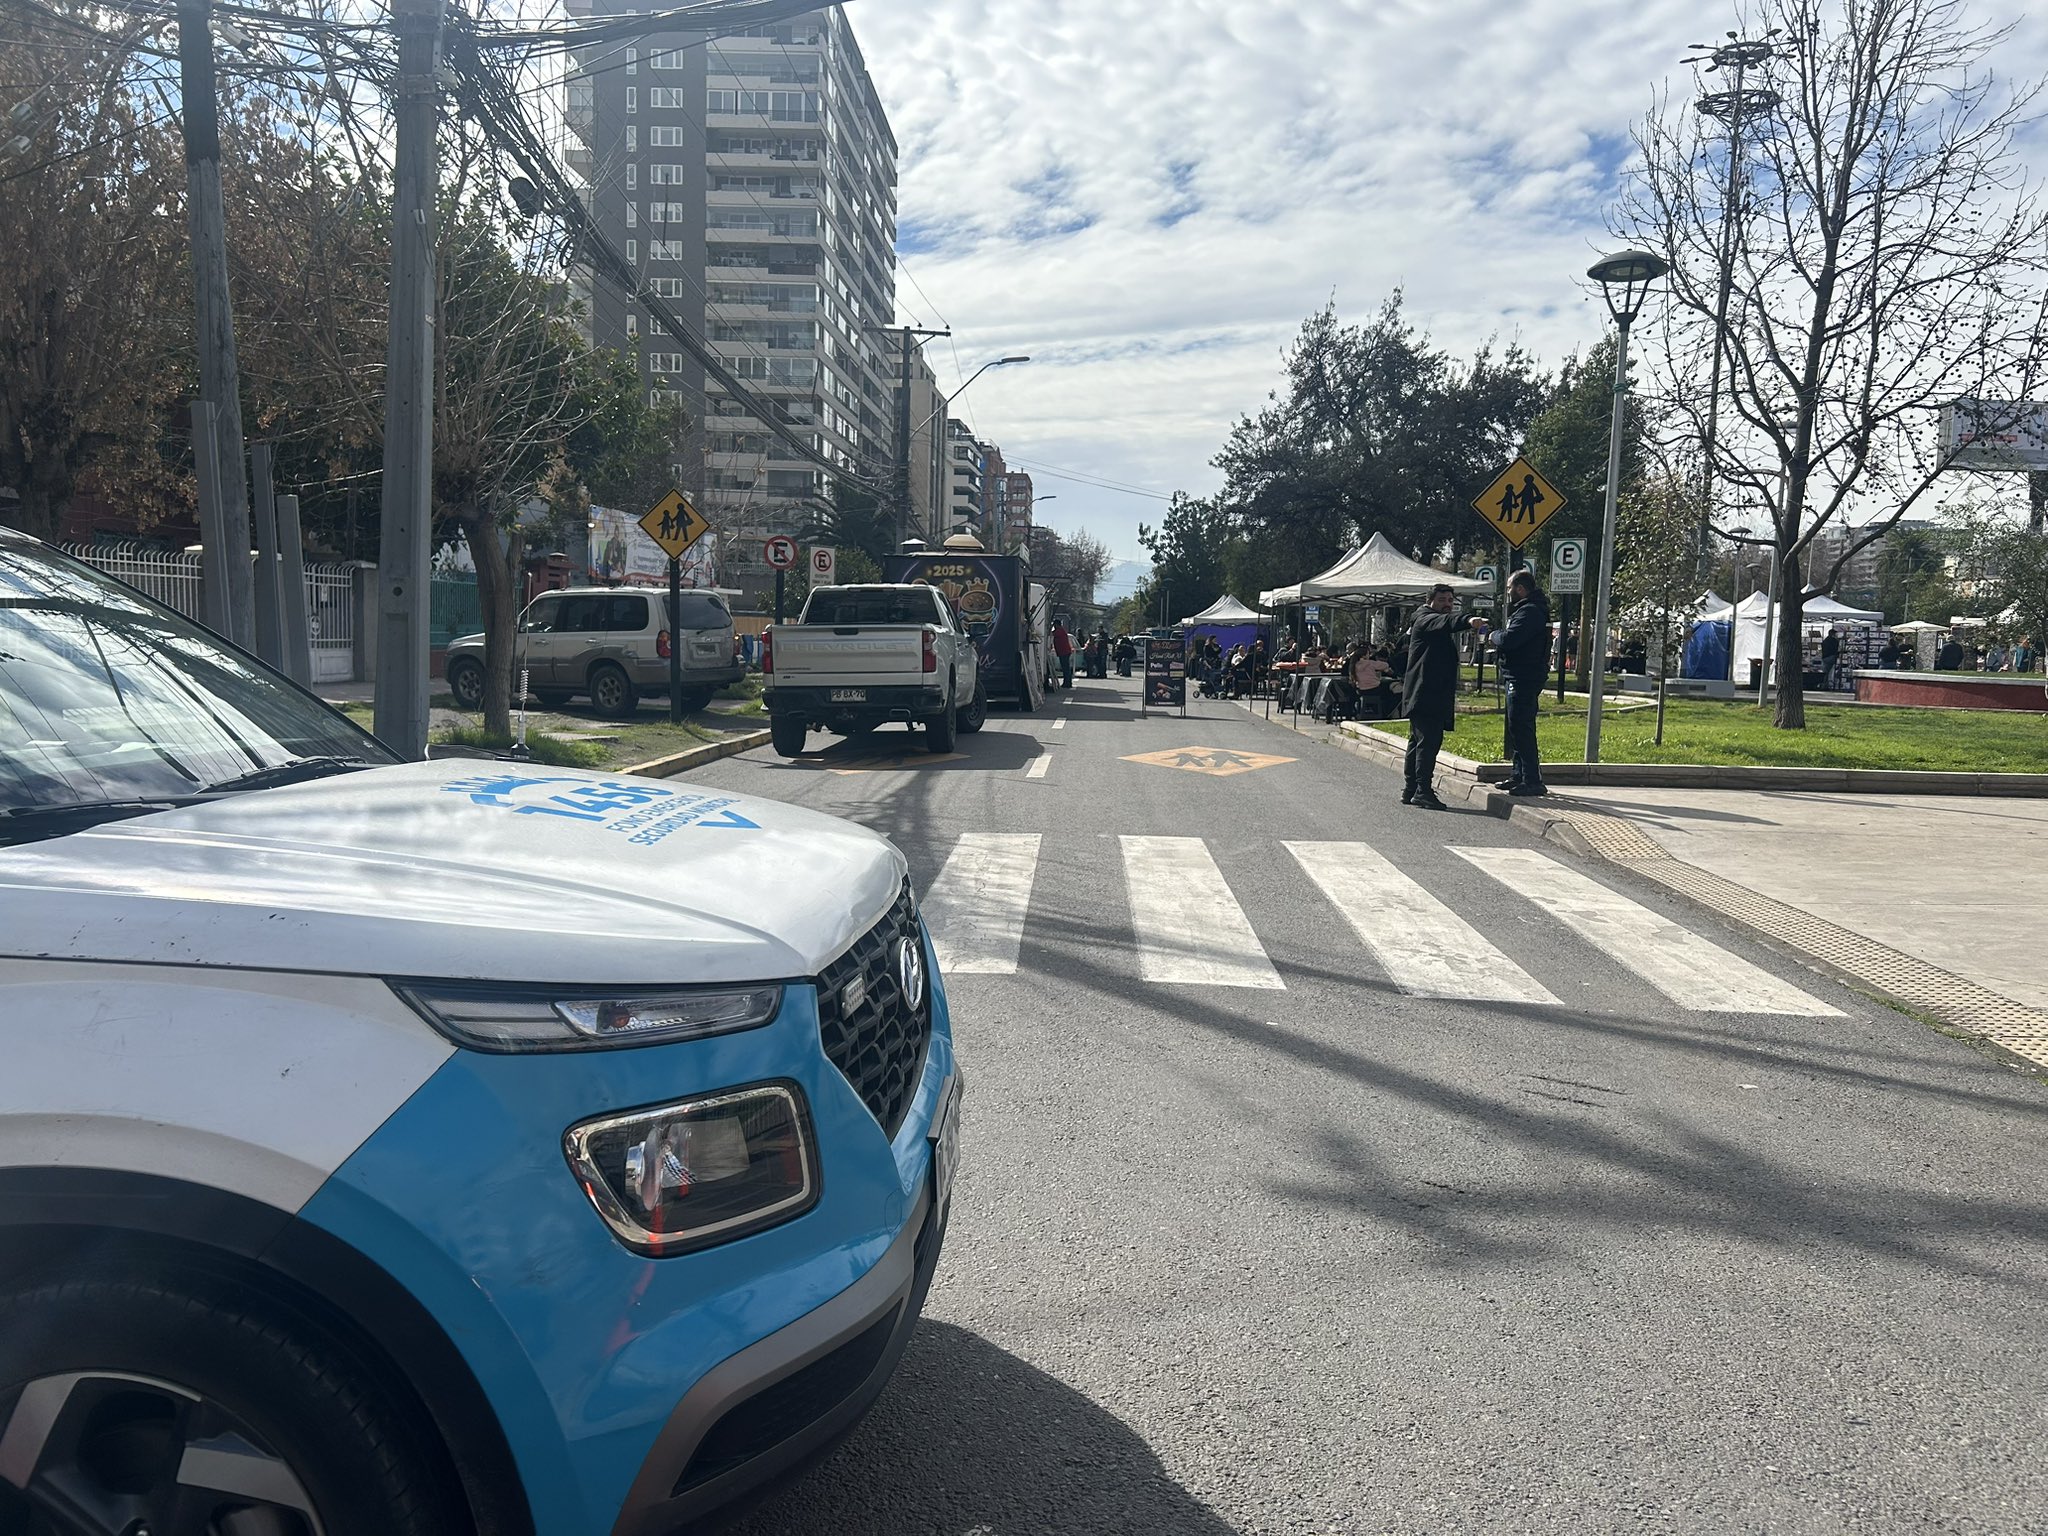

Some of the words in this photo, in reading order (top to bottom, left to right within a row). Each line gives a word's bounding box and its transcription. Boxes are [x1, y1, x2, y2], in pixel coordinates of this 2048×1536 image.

[1562, 547, 1575, 565] E
[932, 564, 965, 577] 2025
[781, 642, 914, 652] CHEVROLET
[512, 782, 674, 822] 1456
[606, 814, 653, 833] FONO
[638, 794, 706, 817] EMERGENCIA
[627, 811, 700, 846] SEGURIDAD
[685, 798, 741, 814] MUNICIPAL
